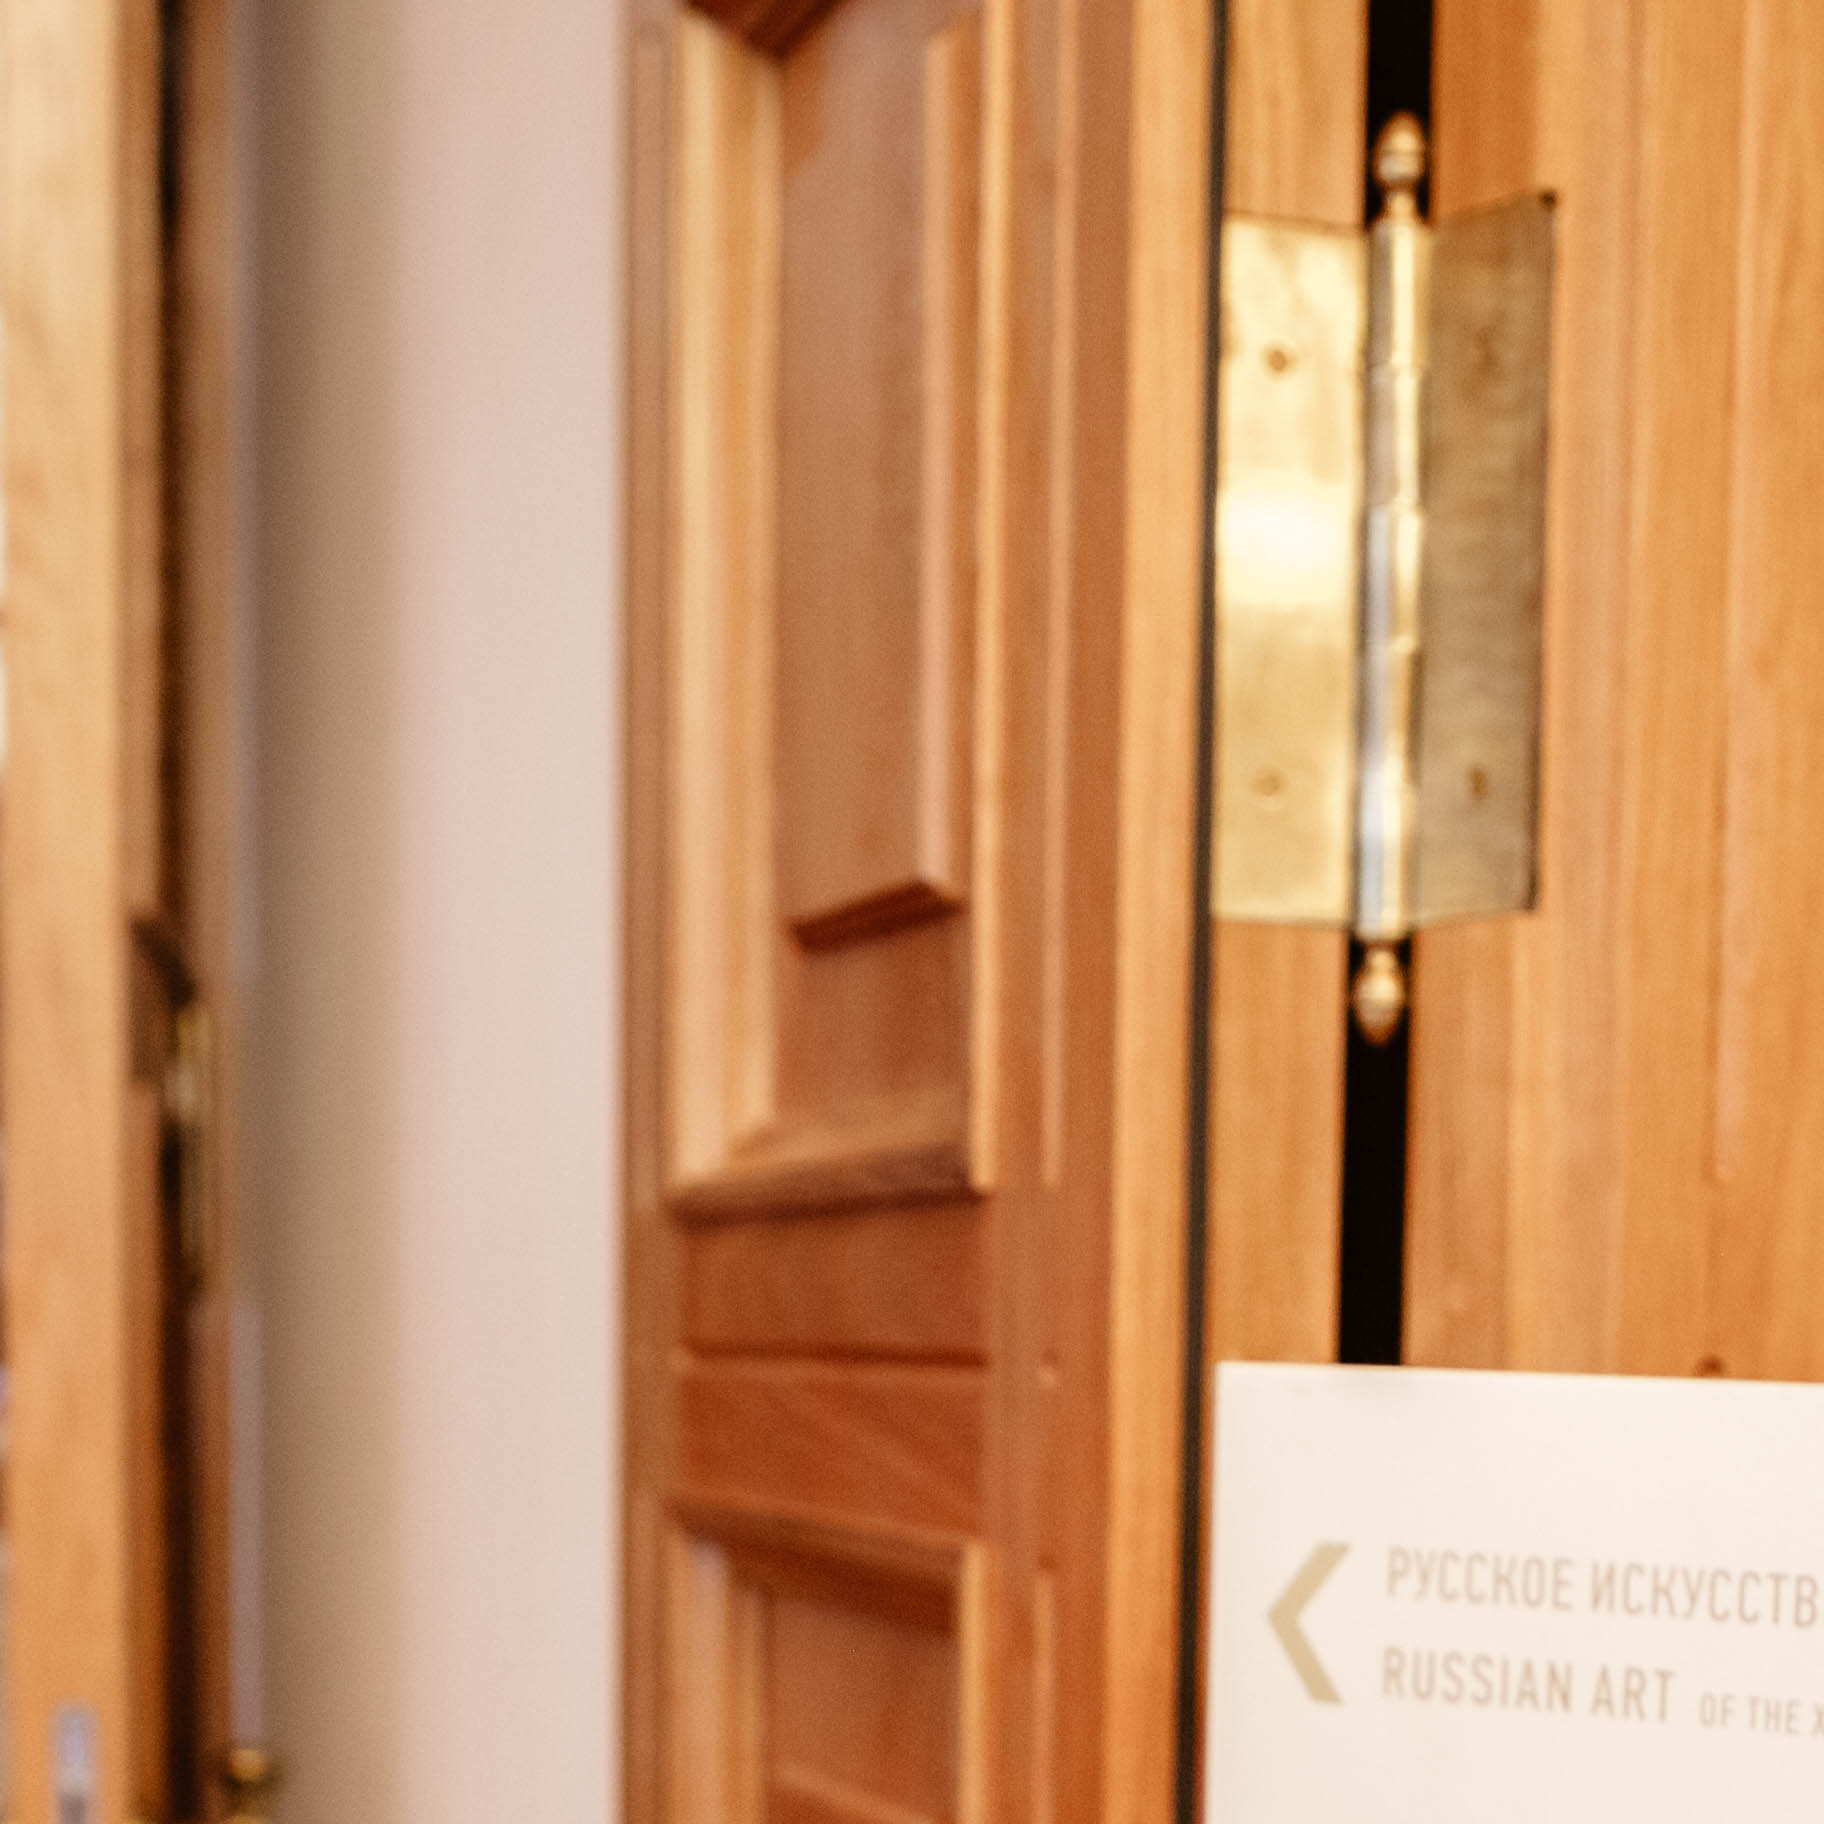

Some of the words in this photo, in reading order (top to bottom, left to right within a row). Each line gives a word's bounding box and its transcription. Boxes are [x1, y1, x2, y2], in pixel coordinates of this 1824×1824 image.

[1387, 1547, 1574, 1612] РУССКОЕ
[1383, 1646, 1573, 1713] RUSSIAN
[1590, 1666, 1676, 1723] ART
[1700, 1691, 1735, 1728] OF
[1749, 1695, 1800, 1735] THE
